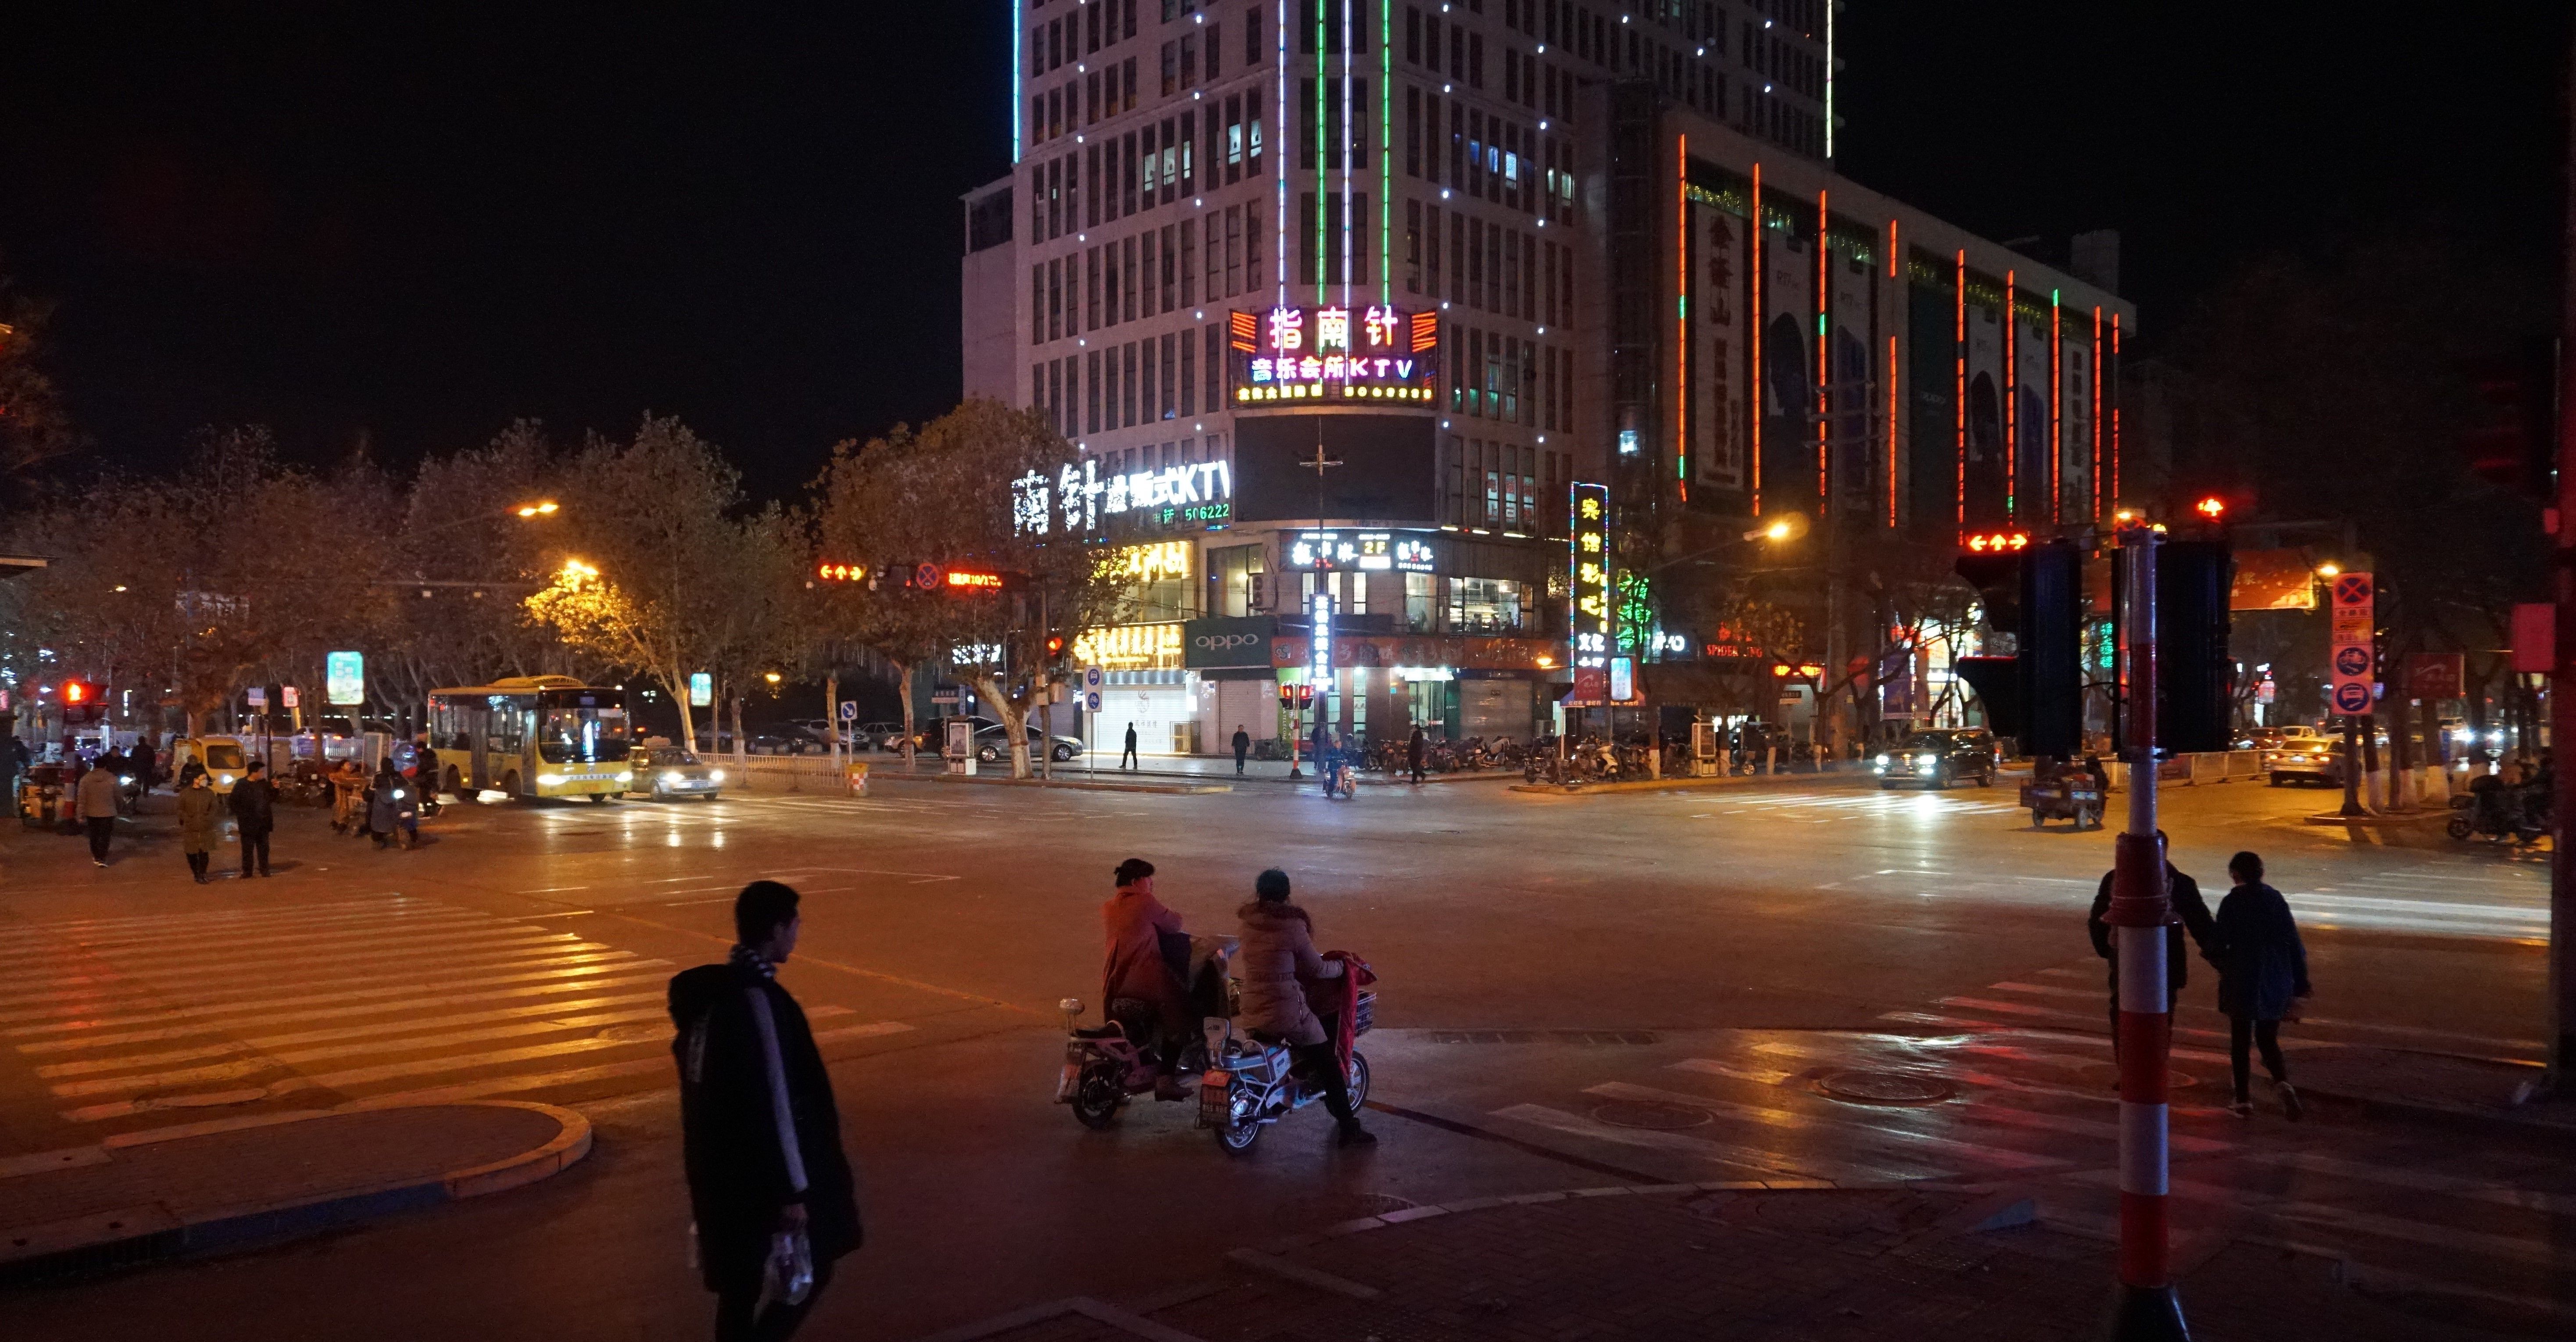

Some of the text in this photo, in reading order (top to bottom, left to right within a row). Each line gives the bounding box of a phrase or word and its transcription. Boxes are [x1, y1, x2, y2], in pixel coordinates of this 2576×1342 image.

[1269, 305, 1398, 350] 指南针
[1251, 355, 1413, 382] 音乐会所KTV
[1707, 644, 1739, 657] SPIDER
